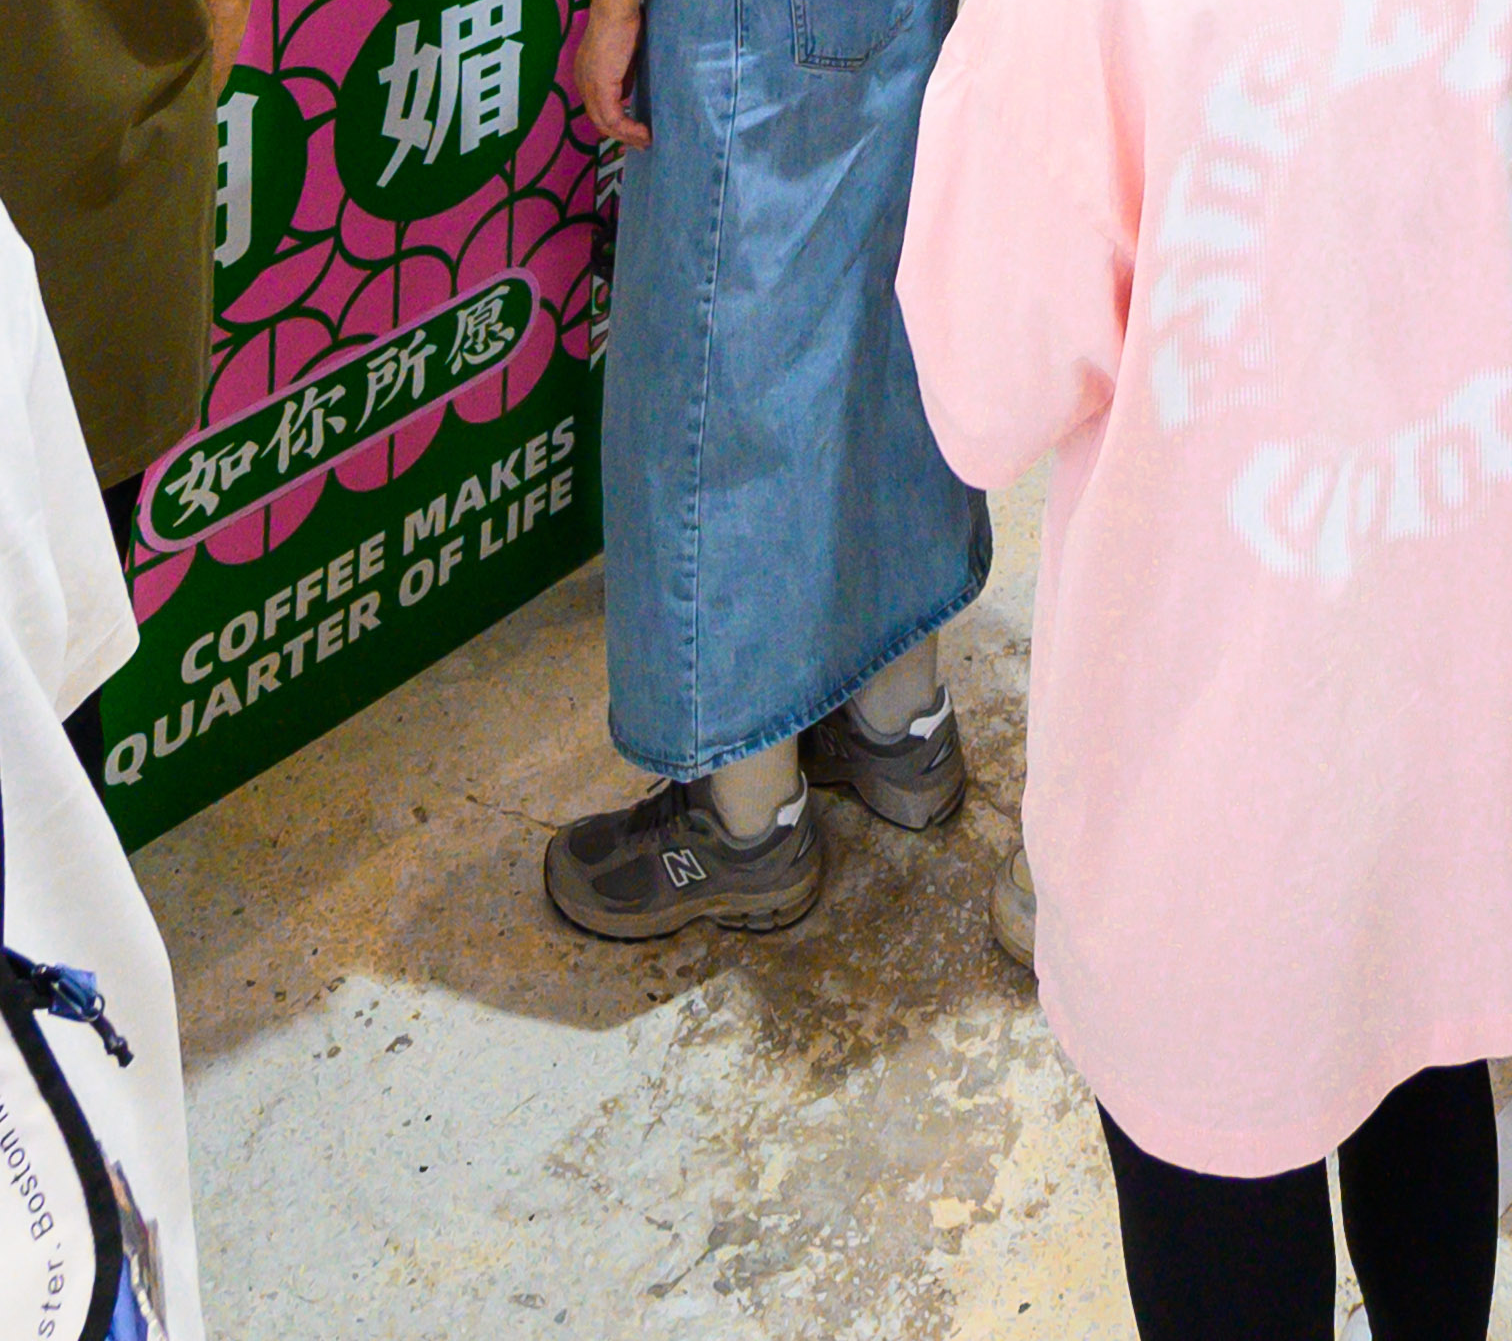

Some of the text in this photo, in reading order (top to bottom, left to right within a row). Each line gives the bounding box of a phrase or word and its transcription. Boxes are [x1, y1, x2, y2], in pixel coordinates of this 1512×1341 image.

[165, 283, 516, 532] 如你所愿
[103, 475, 574, 788] QUARTER OF LIFE
[180, 414, 576, 686] COFFEE MAKES
